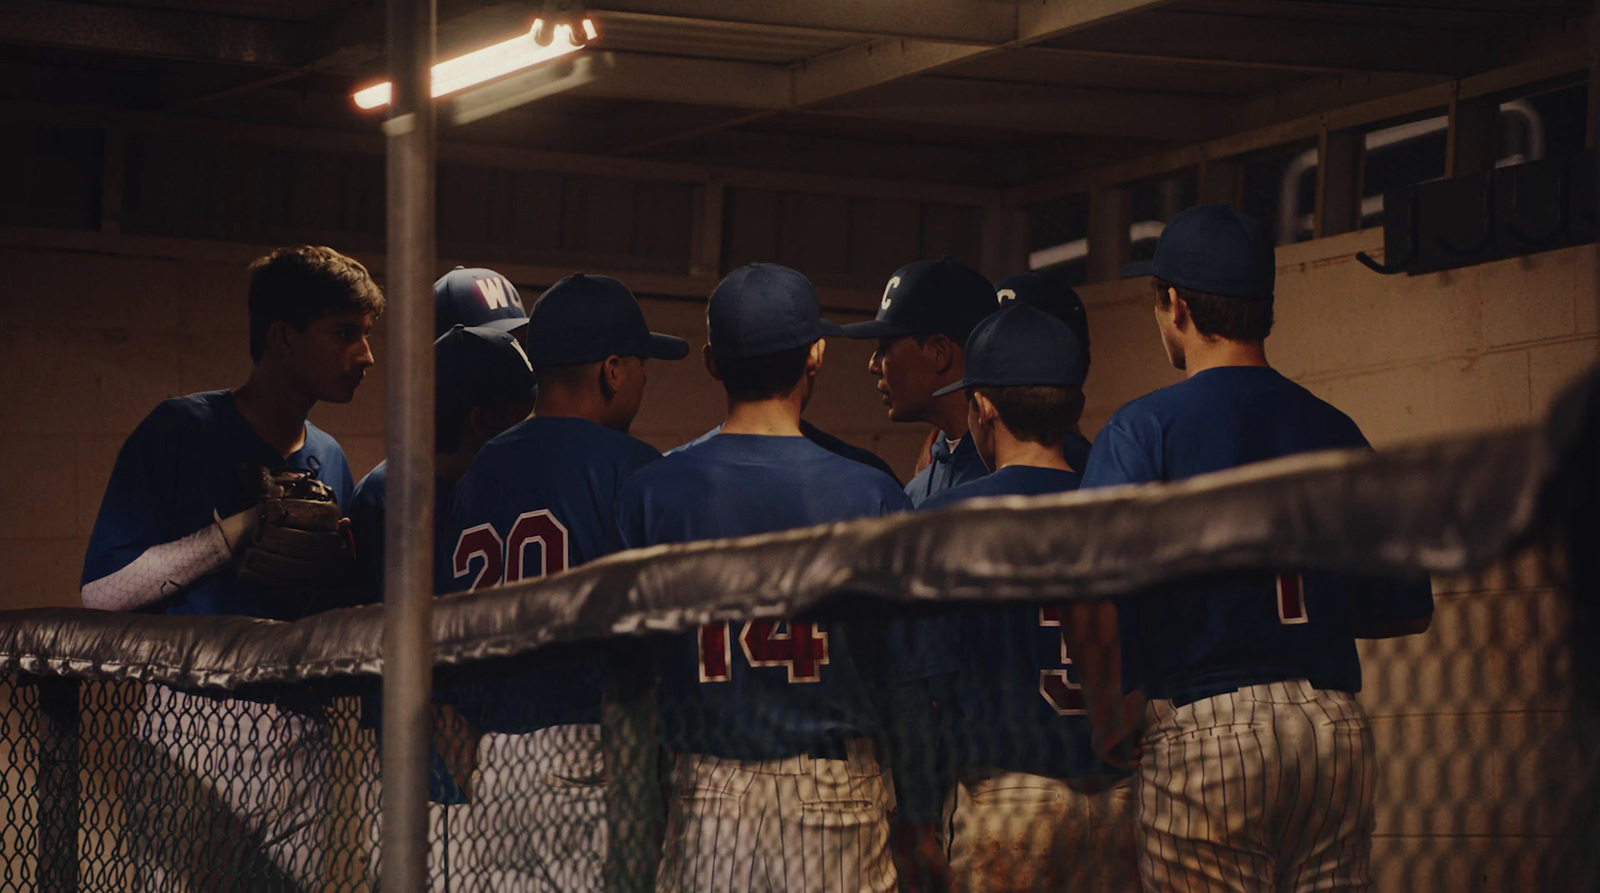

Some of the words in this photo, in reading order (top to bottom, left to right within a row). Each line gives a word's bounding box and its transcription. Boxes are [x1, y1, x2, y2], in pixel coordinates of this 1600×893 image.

[881, 275, 901, 310] C
[452, 508, 569, 594] 20
[697, 616, 830, 684] 14
